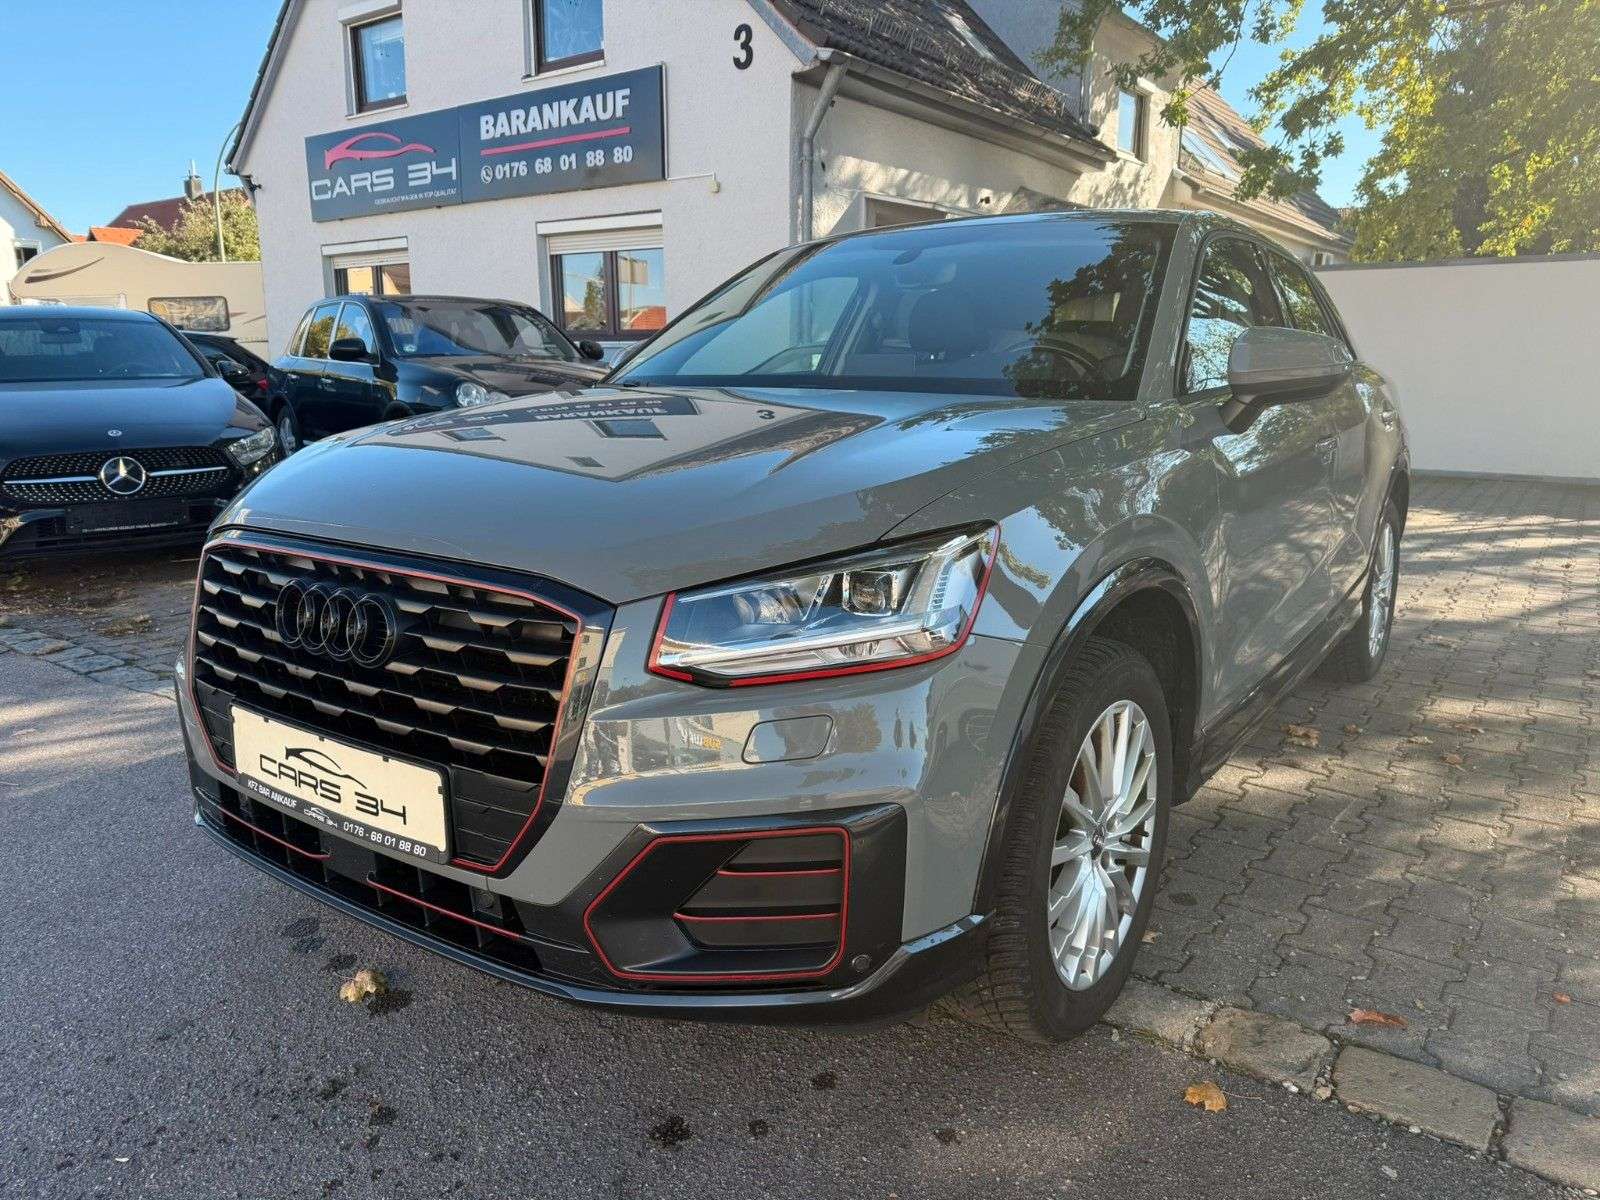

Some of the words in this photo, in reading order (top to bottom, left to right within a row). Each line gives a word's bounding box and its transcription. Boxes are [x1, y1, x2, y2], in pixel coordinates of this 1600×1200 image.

[733, 23, 753, 70] 3
[480, 88, 631, 141] BARANKAUF
[311, 168, 395, 201] CARS
[407, 157, 457, 187] 34
[495, 160, 528, 180] 0176
[535, 157, 552, 174] 68
[560, 153, 577, 171] 01
[586, 150, 605, 168] 88
[613, 145, 633, 164] 80
[247, 779, 258, 791] KFZ
[258, 785, 271, 798] BAR
[271, 790, 297, 808] ANKAUF
[259, 753, 342, 804] CARS
[355, 791, 407, 826] 34
[343, 822, 365, 837] 0176
[371, 831, 383, 843] 68
[384, 836, 396, 847] 01
[399, 840, 411, 852] 88
[413, 845, 427, 857] 80
